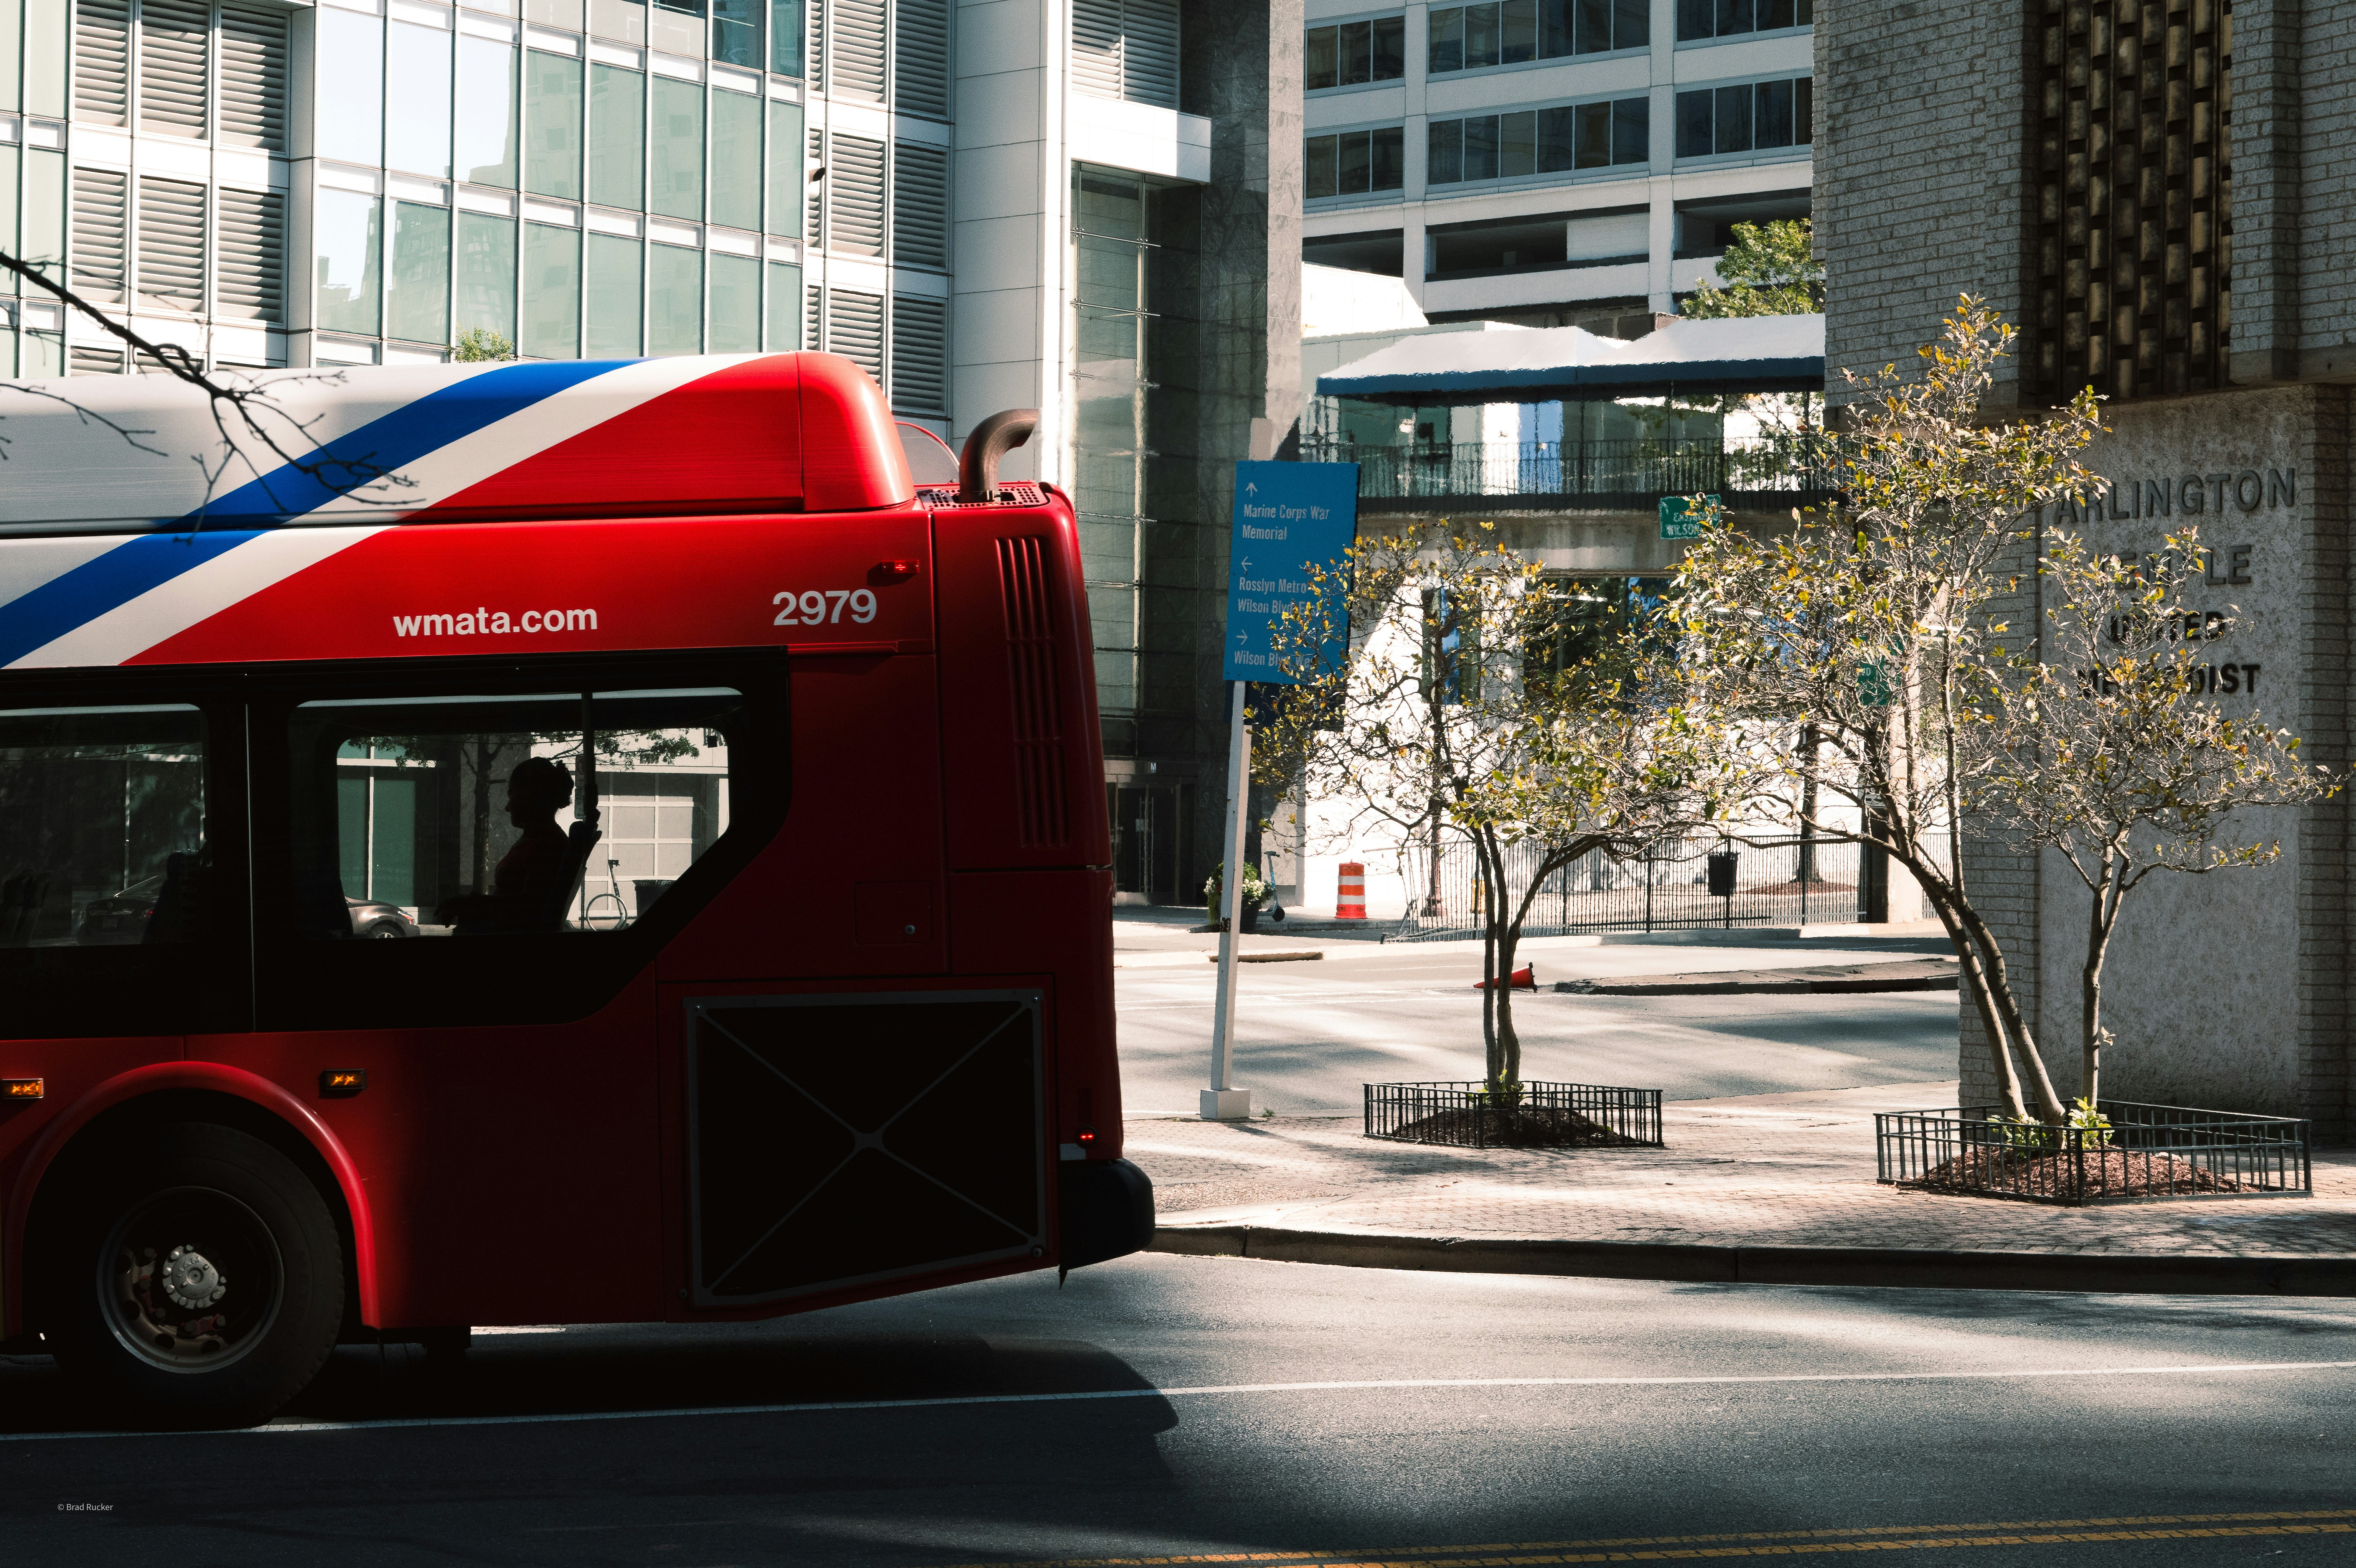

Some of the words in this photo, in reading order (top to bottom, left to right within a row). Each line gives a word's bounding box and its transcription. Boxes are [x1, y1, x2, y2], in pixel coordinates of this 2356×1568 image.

[2054, 468, 2296, 524] ARLINGTON
[1244, 503, 1276, 518] Marine
[1279, 504, 1307, 522] Corps
[1310, 505, 1330, 520] War
[1242, 524, 1287, 540] Memorial
[1239, 577, 1276, 594] Rosslyn
[1278, 578, 1307, 594] Metro
[772, 589, 877, 625] 2979
[1238, 598, 1269, 613] Wilson
[1299, 601, 1319, 616] Es
[393, 607, 597, 637] wmata.com
[2110, 611, 2226, 642] UITED
[1234, 650, 1265, 666] Wilson
[1296, 654, 1317, 668] We
[2077, 663, 2261, 697] MEDIST
